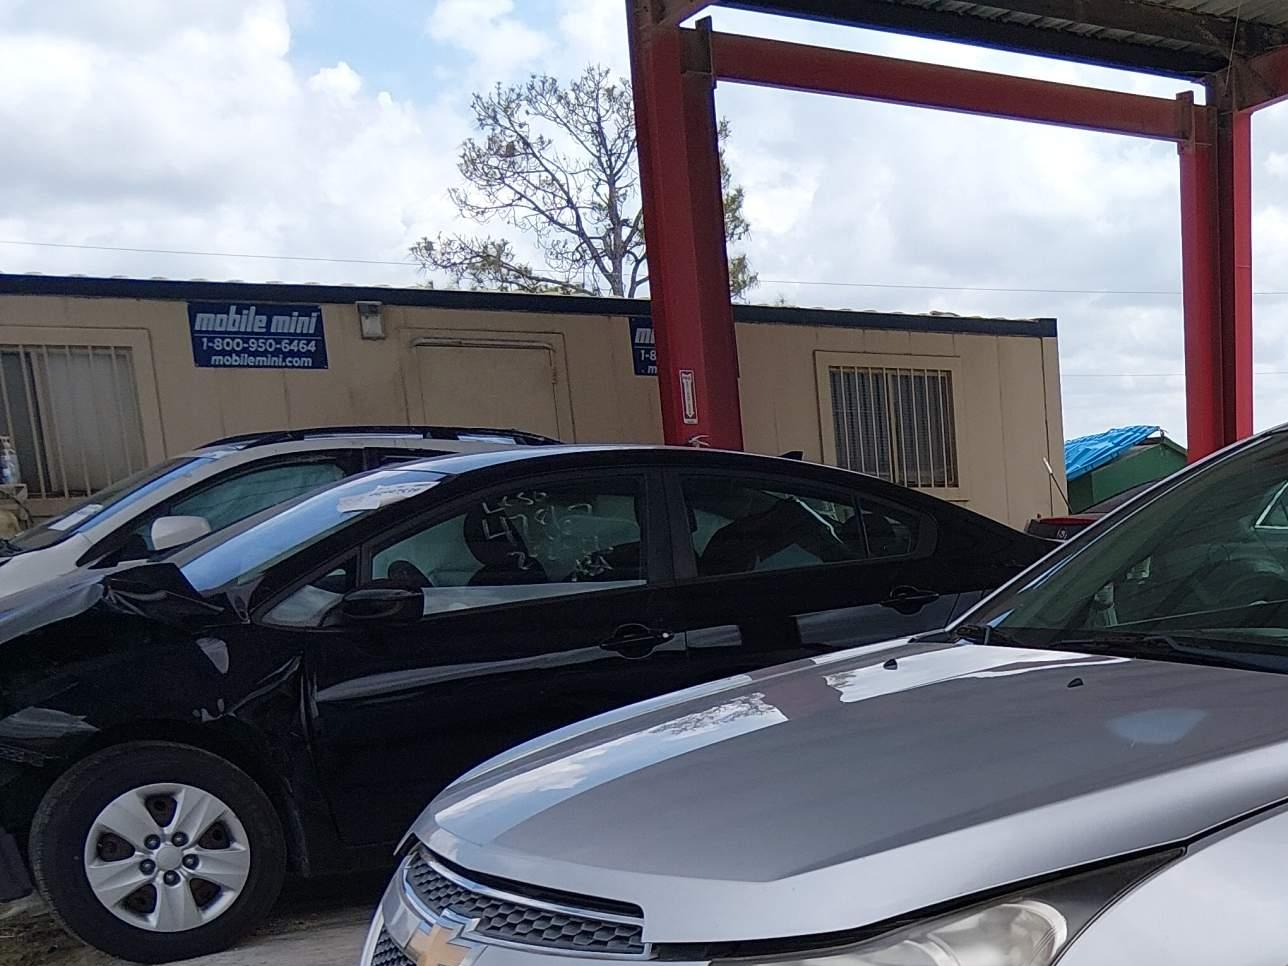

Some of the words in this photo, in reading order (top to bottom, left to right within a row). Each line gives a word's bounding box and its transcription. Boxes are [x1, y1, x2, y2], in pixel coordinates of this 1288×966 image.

[194, 305, 267, 332] mobile
[270, 311, 318, 334] mini
[201, 337, 316, 352] 1-800-950-6464
[210, 353, 313, 367] mobilemini.com
